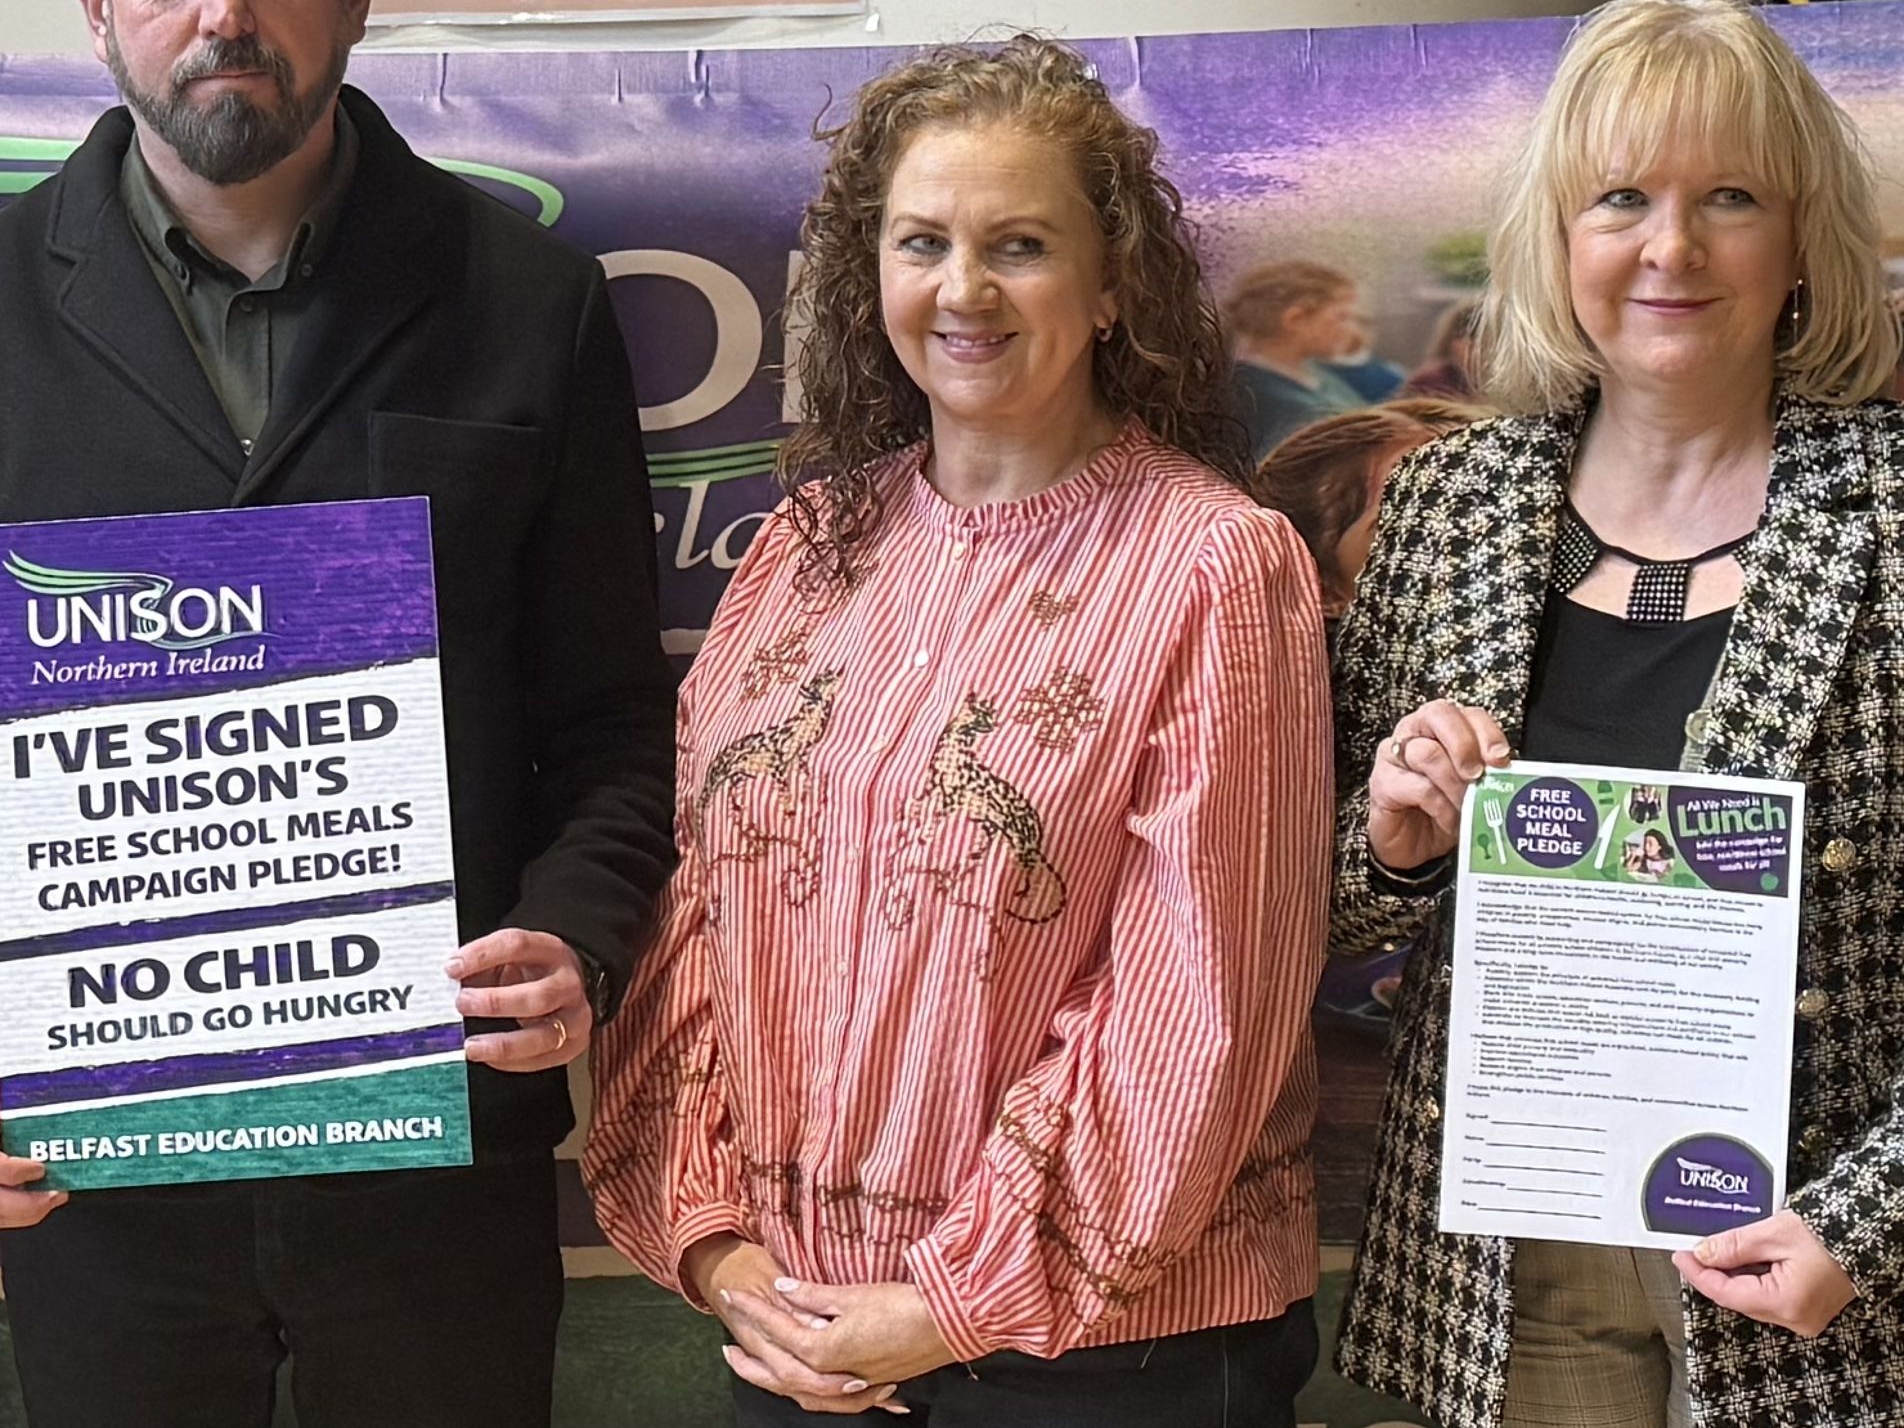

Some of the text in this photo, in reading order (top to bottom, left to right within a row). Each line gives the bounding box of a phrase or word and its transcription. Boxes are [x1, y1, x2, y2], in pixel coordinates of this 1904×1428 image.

[26, 584, 263, 648] UNISON
[31, 644, 265, 686] Northern Ireland
[12, 694, 399, 779] I'VE SIGNED
[78, 755, 349, 820] UNISON'S
[1530, 788, 1572, 804] FREE
[27, 801, 414, 870] FREE SCHOOL MEALS
[1516, 804, 1587, 822] SCHOOL
[1525, 821, 1572, 838] MEAL
[1677, 796, 1786, 837] Lunch
[1517, 838, 1583, 855] PLEDGE
[37, 844, 401, 913] CAMPAIGN PLEDGE!
[67, 932, 381, 1009] NO CHILD
[47, 984, 415, 1051] SHOULD GO HUNGRY
[29, 1116, 444, 1163] BELFAST EDUCATION BRANCH
[1680, 1169, 1748, 1190] UNISON
